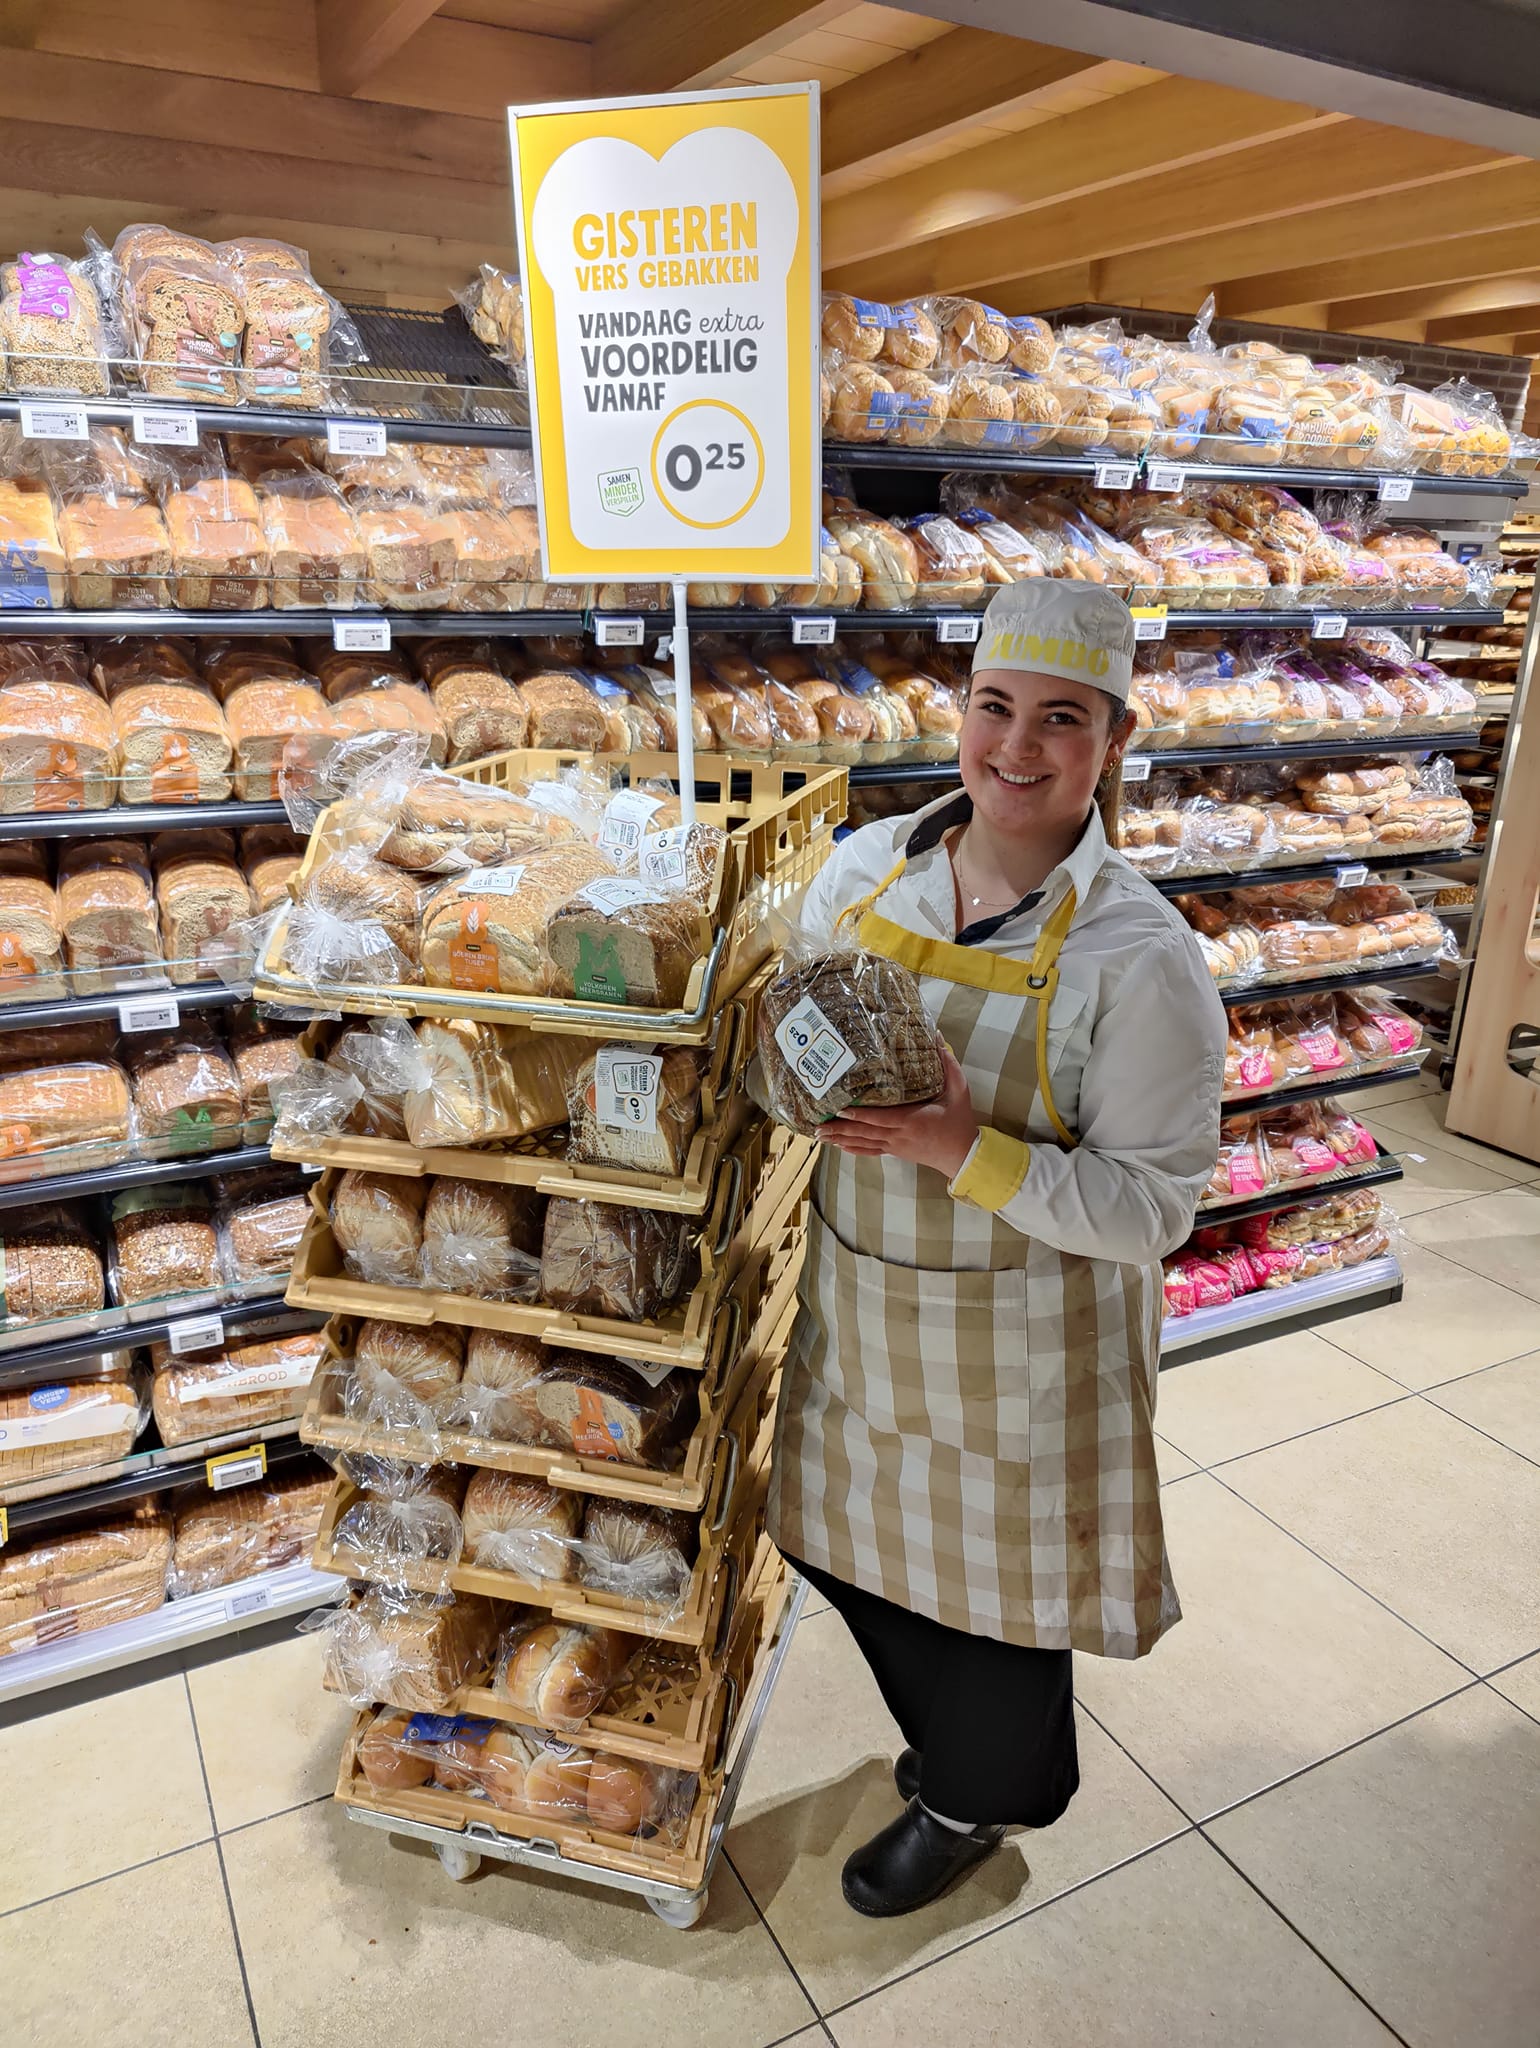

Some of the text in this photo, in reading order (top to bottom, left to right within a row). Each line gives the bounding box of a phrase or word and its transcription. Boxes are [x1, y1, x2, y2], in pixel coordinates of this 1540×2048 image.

[573, 202, 758, 261] GISTEREN
[575, 255, 759, 291] VERS GEBAKKEN
[578, 307, 764, 339] VANDAAG extra
[580, 338, 758, 378] VOORDELIG
[583, 382, 666, 413] VANAF
[606, 473, 632, 487] SAMEN
[604, 482, 638, 499] MINDER
[606, 494, 640, 507] VERSPILLEN
[215, 584, 252, 596] VOLKOREN
[987, 632, 1111, 677] JUMBO
[584, 981, 617, 992] VOLKOREN
[33, 1388, 65, 1402] LANGER
[40, 1395, 62, 1405] VERS
